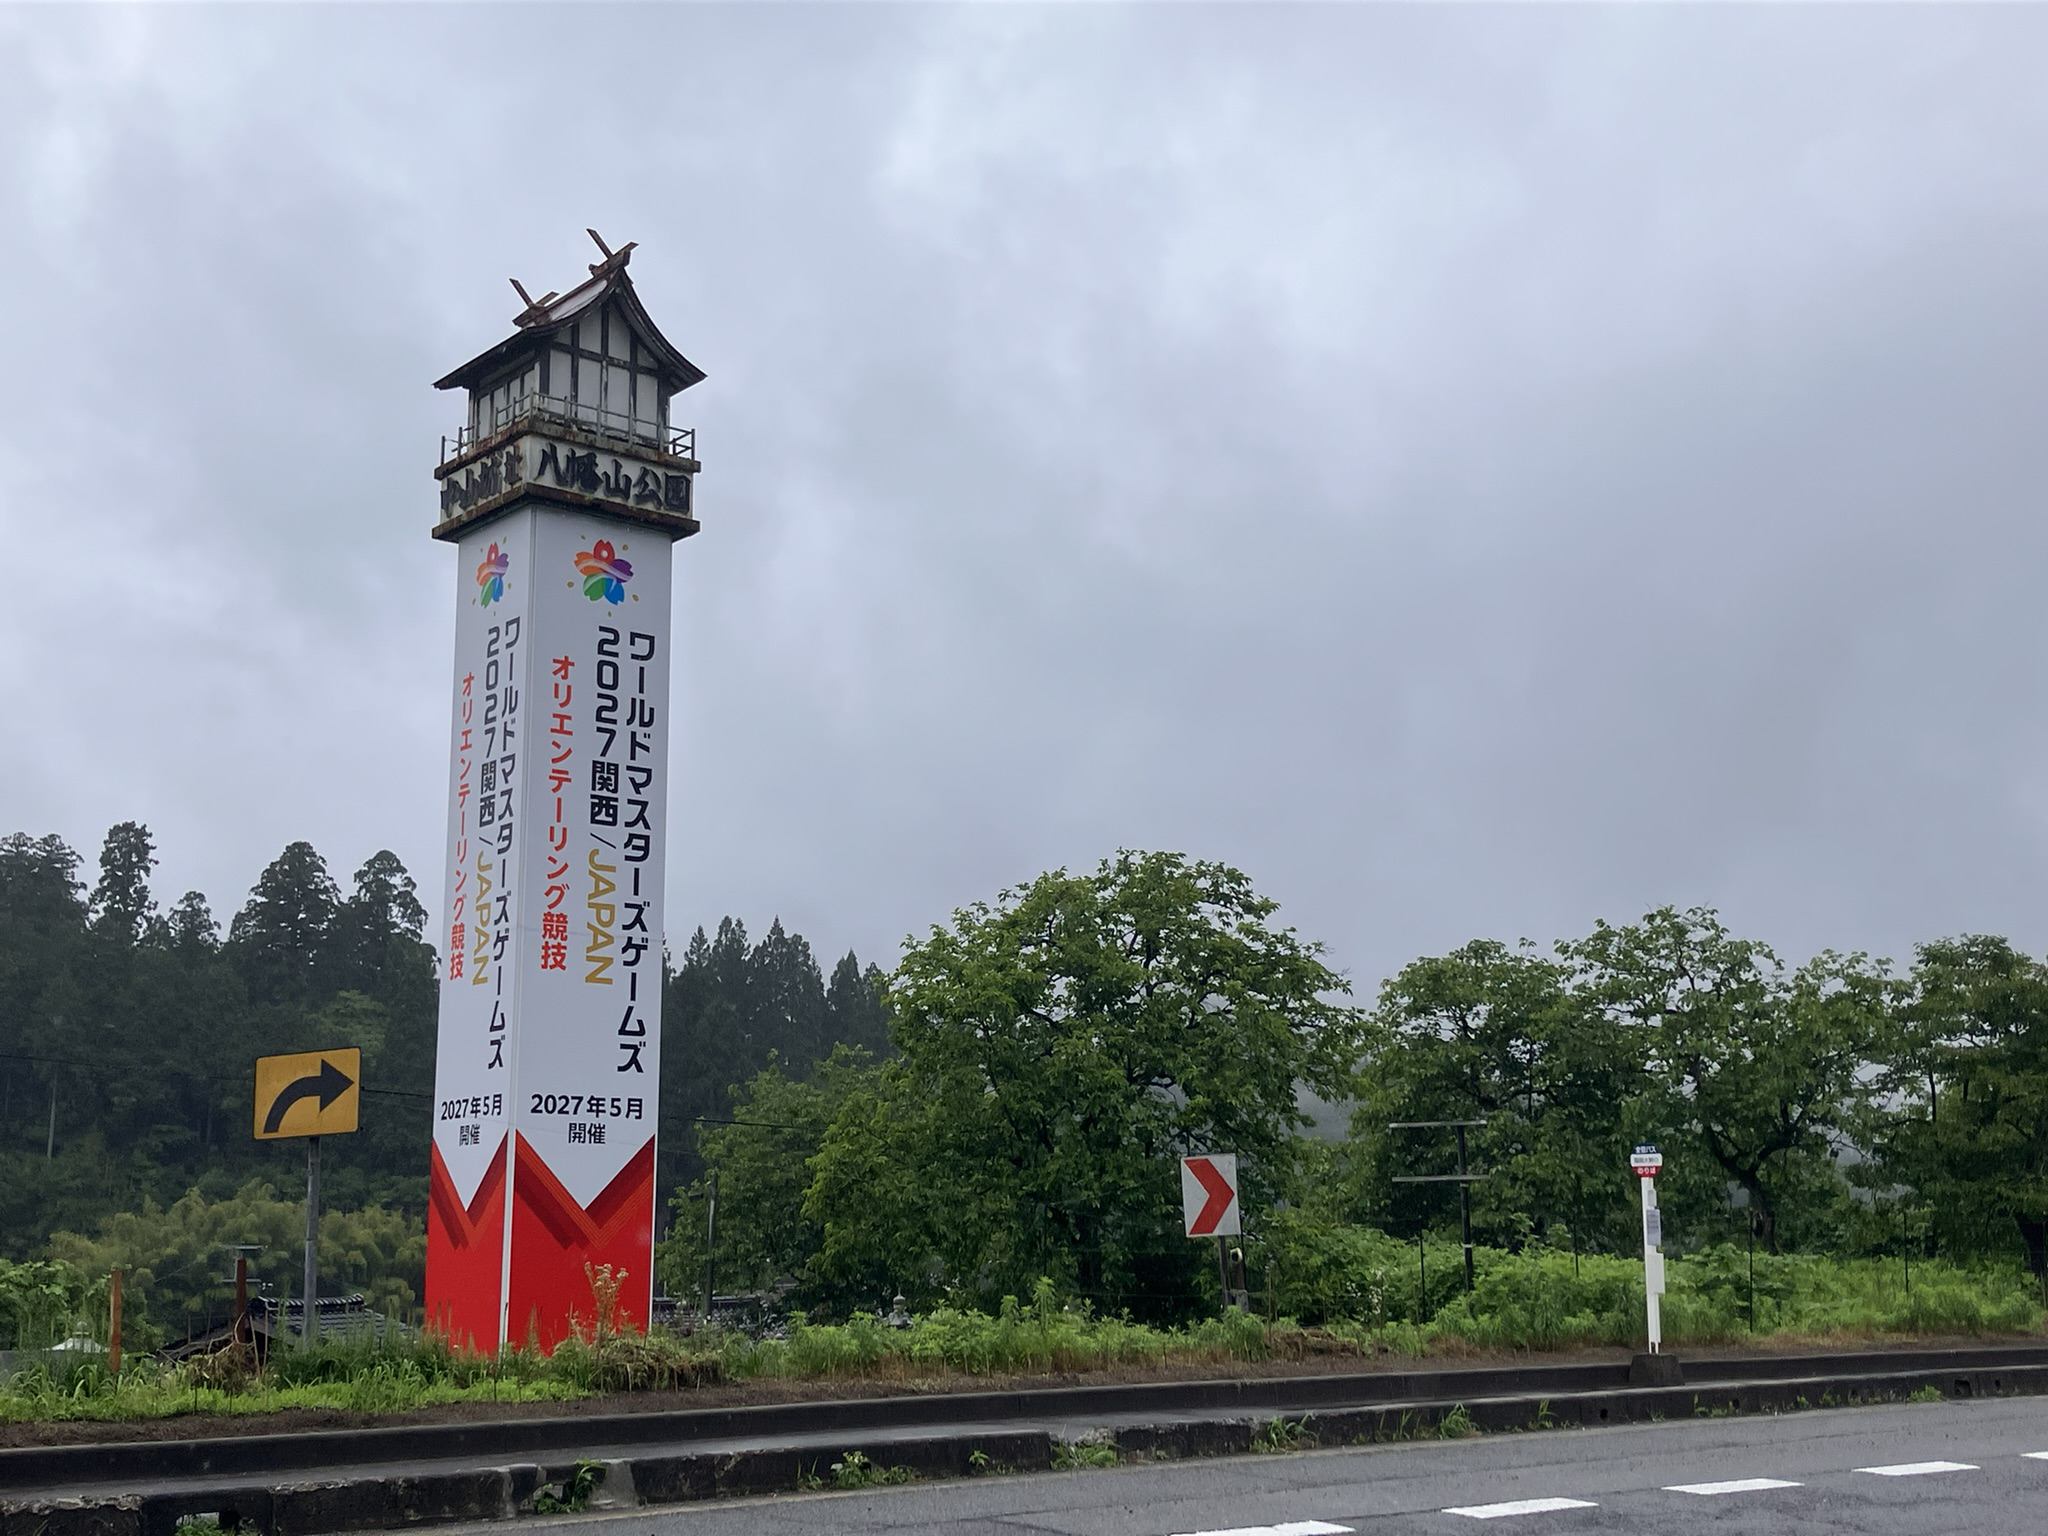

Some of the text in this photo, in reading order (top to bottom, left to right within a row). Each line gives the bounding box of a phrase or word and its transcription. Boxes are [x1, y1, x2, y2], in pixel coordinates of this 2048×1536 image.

[449, 672, 475, 981] オリエンテーリング競技
[488, 616, 521, 1070] ワールドマスターズゲームズ
[540, 655, 575, 972] オリエンテーリング競技
[617, 631, 656, 1074] ワールドマスターズゲームズ
[440, 1092, 503, 1121] 2027年5月
[458, 1123, 481, 1147] 開催
[530, 1093, 644, 1121] 2027年5月
[567, 1122, 606, 1145] 開催
